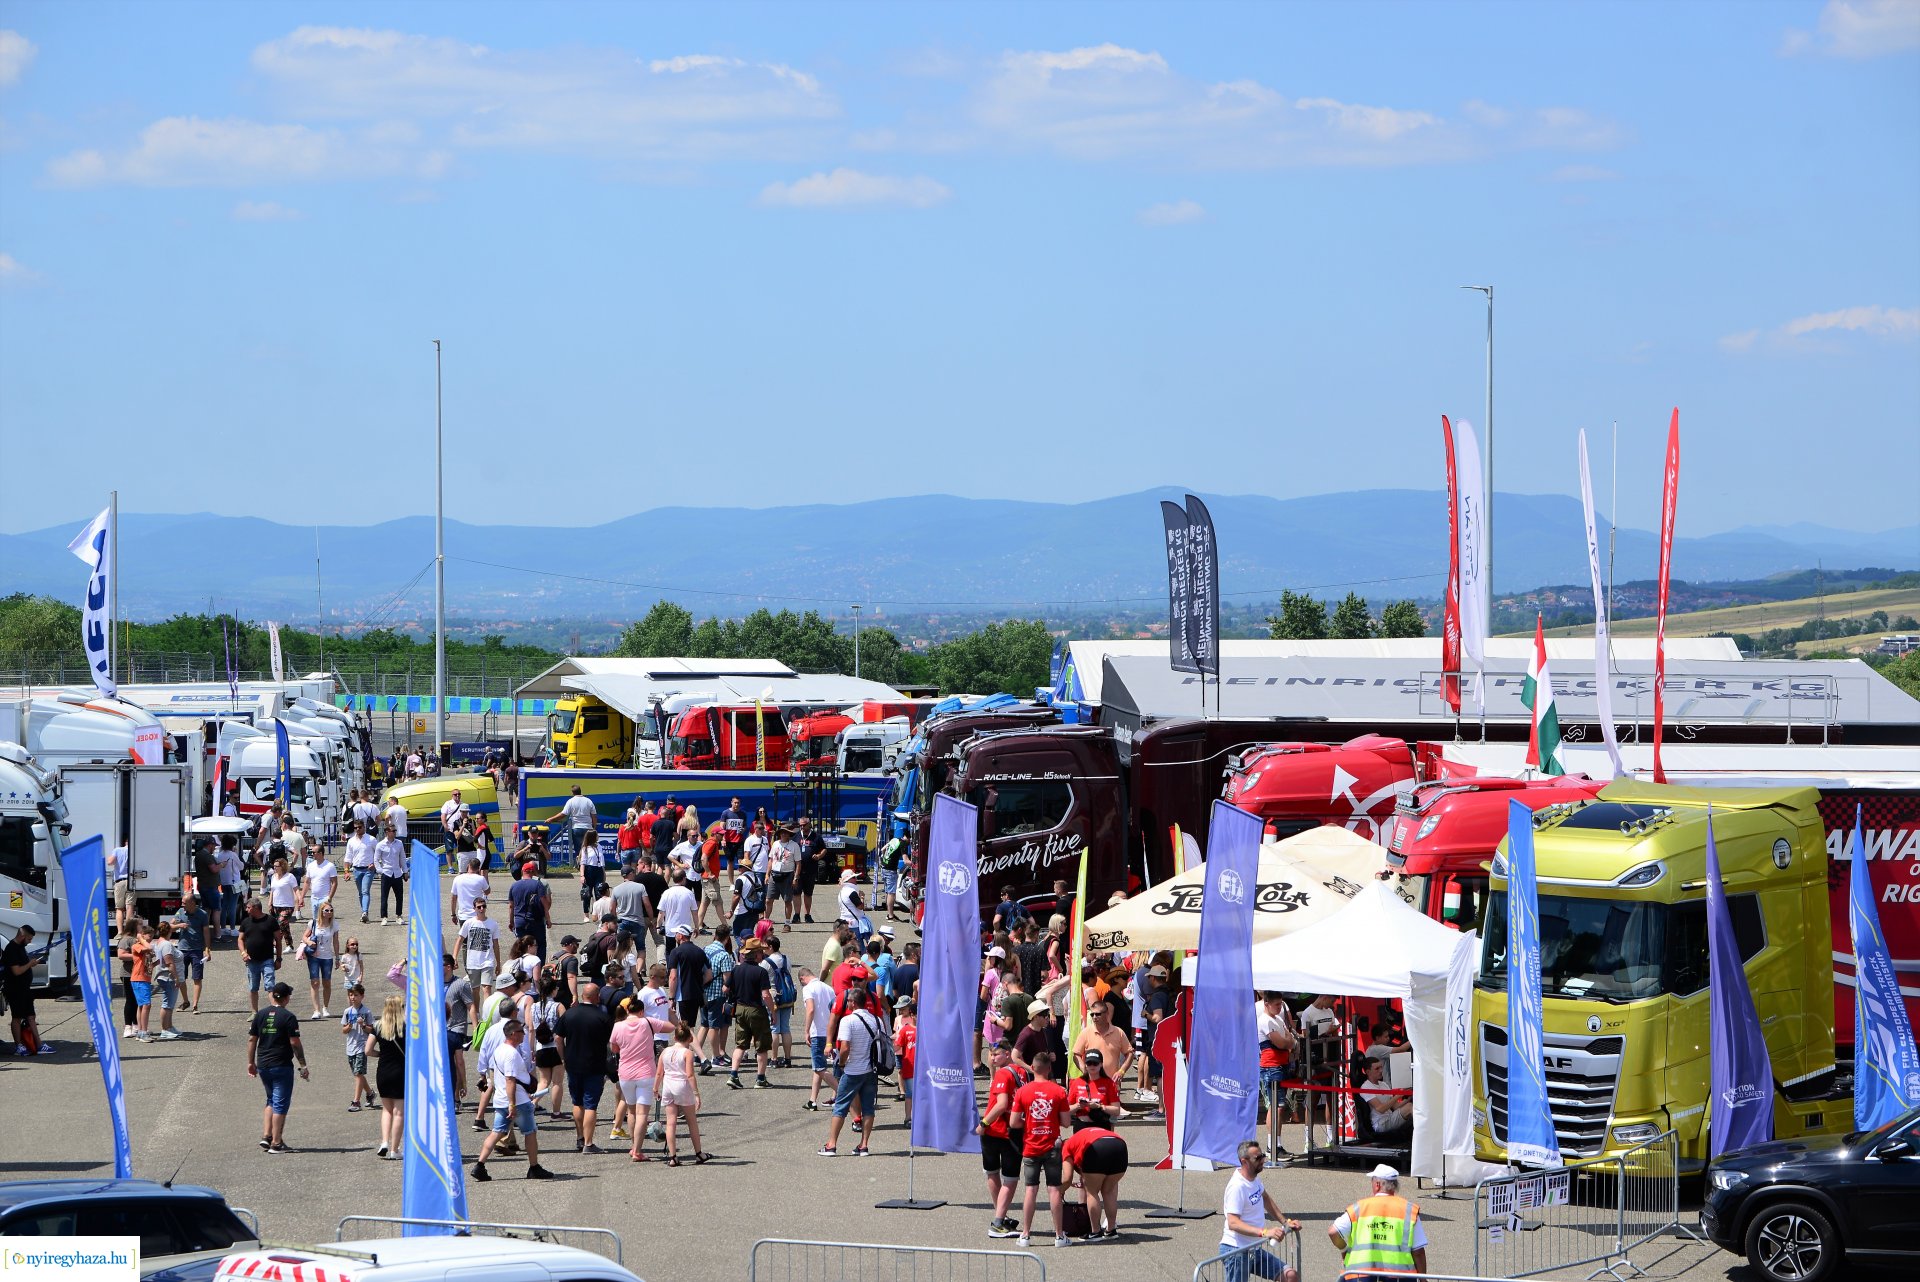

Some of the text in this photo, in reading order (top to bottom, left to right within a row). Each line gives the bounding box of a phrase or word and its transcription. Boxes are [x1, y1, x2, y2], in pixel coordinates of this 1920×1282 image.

[1752, 682, 1825, 691] KG
[984, 773, 1032, 781] RACE-LINE
[977, 833, 1082, 878] twenty five
[409, 916, 421, 1039] GOODYEAR
[1869, 956, 1887, 991] TRUCK
[1886, 993, 1908, 1050] EUROPEAN
[936, 1067, 962, 1077] ACTION
